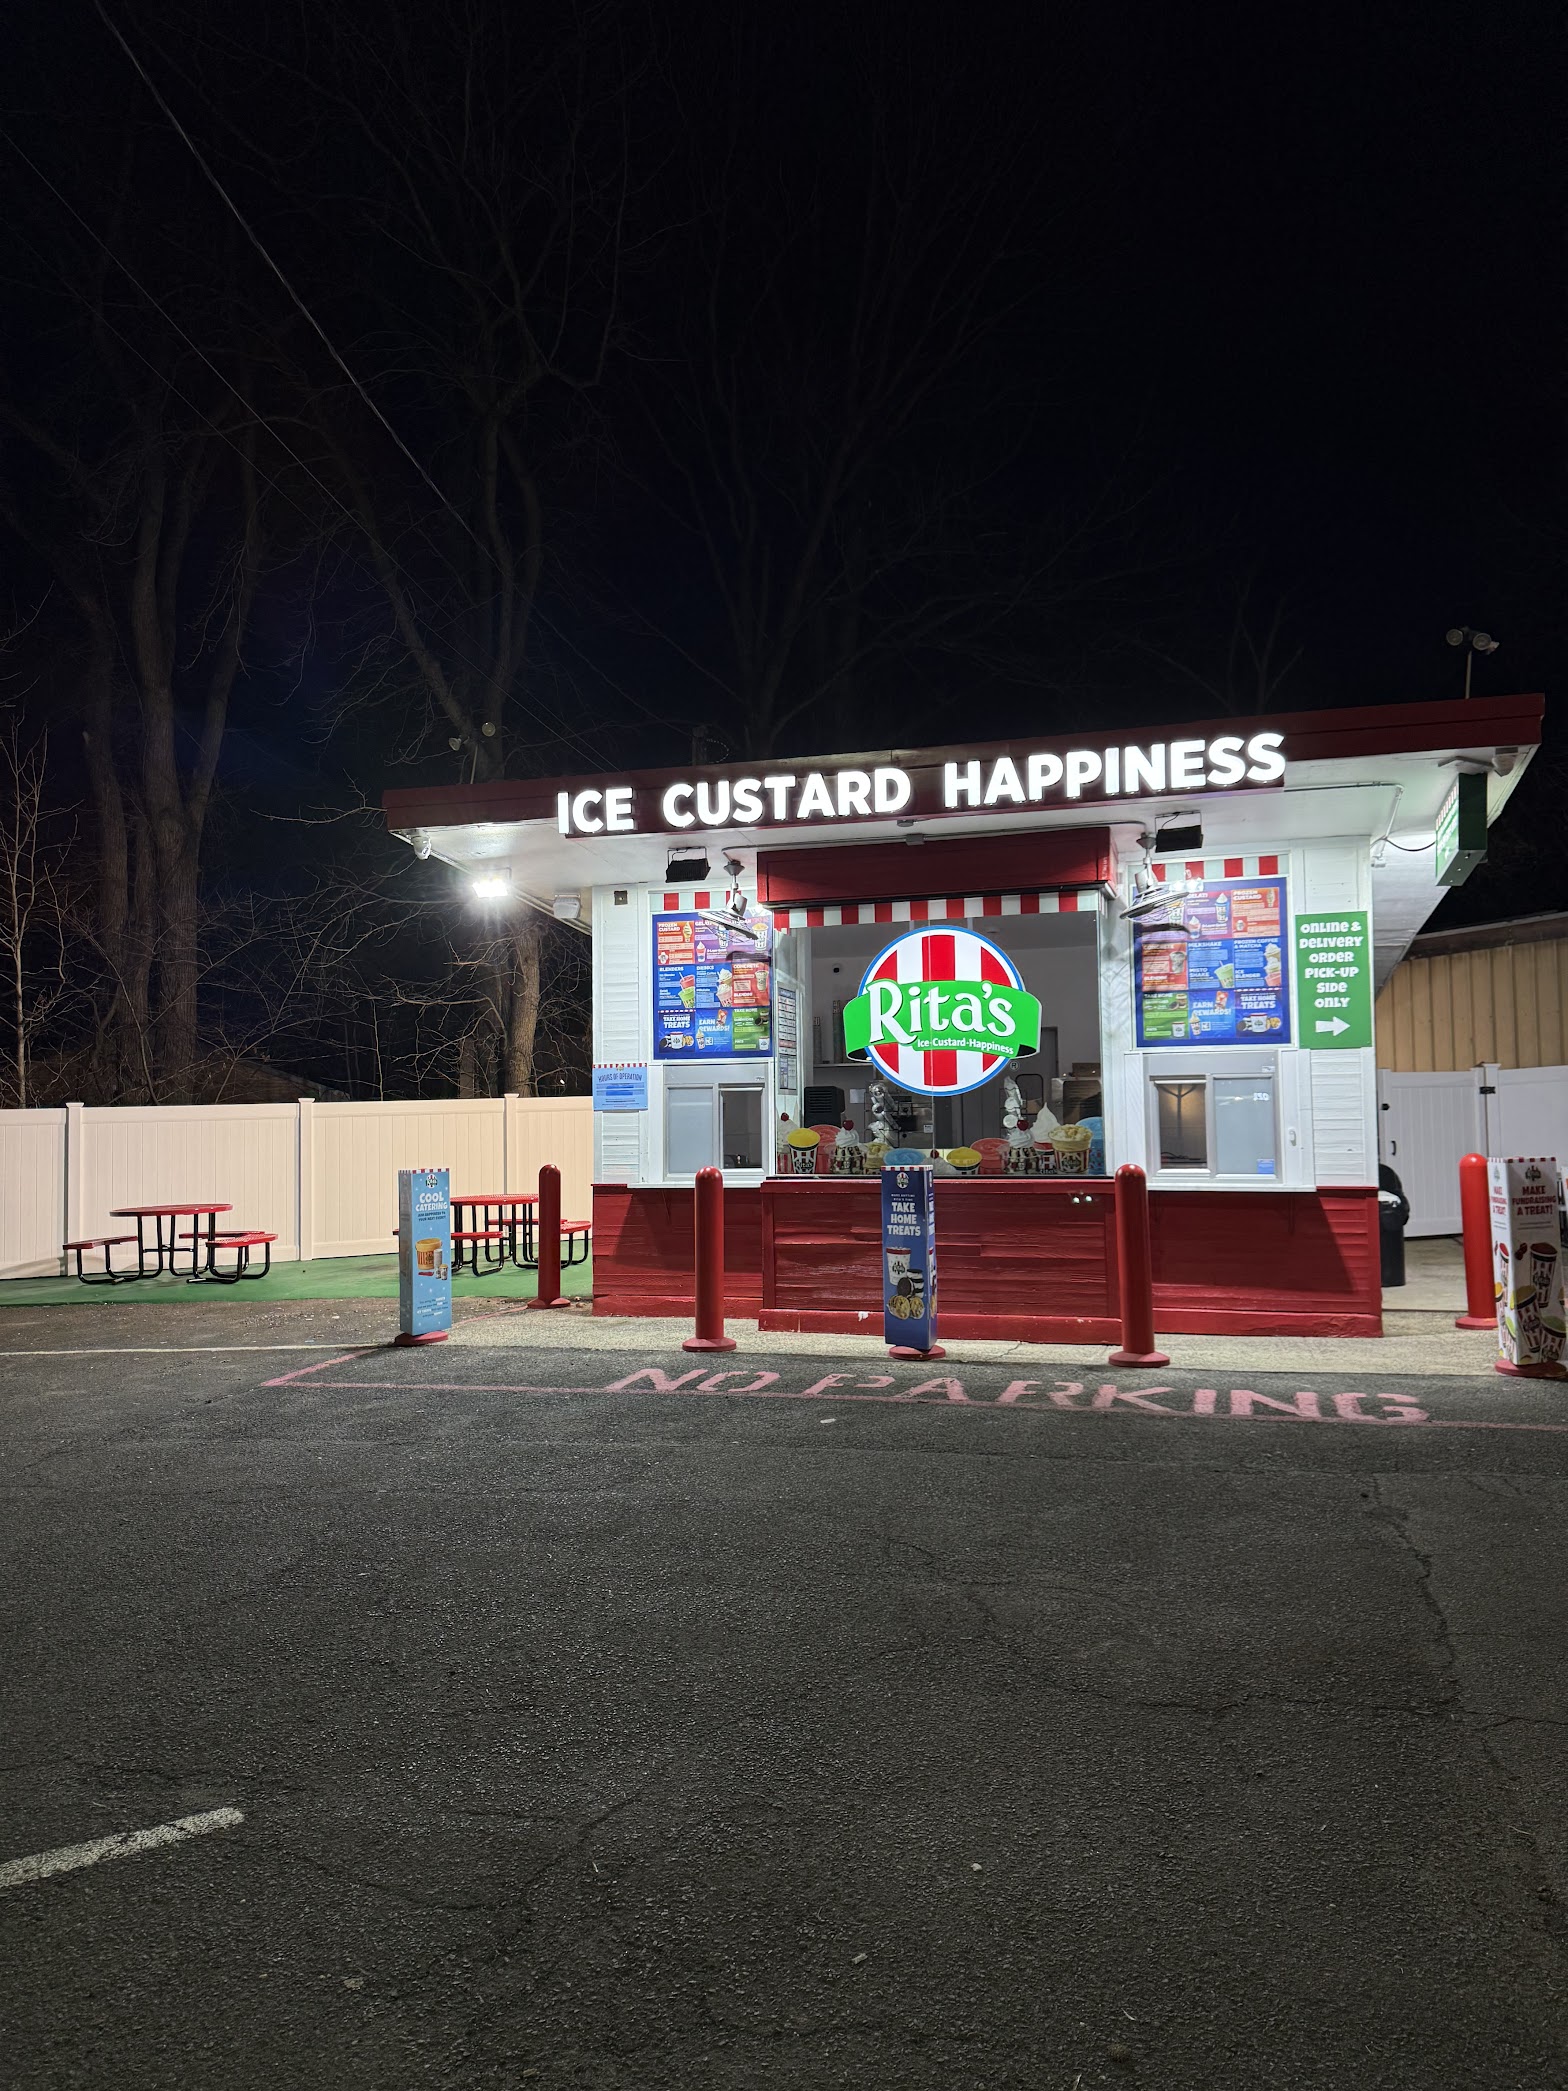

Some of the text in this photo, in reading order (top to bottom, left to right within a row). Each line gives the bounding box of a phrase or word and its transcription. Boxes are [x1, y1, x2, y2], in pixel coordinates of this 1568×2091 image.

[558, 732, 1286, 834] ICE CUSTARD HAPPINESS
[1350, 921, 1362, 932] &
[1240, 1001, 1276, 1009] TREATS
[866, 980, 1016, 1044] Rita's
[663, 1021, 691, 1029] TREATS
[1522, 1185, 1546, 1196] MAKE
[419, 1191, 445, 1204] COOL
[1512, 1195, 1556, 1205] FUNDRAISING
[415, 1201, 448, 1212] CATERING
[891, 1201, 915, 1213] TAKE
[1517, 1204, 1553, 1216] A TREAT!
[890, 1213, 917, 1225] HOME
[887, 1224, 921, 1237] TREATS
[602, 1368, 1430, 1424] NO PARKING
